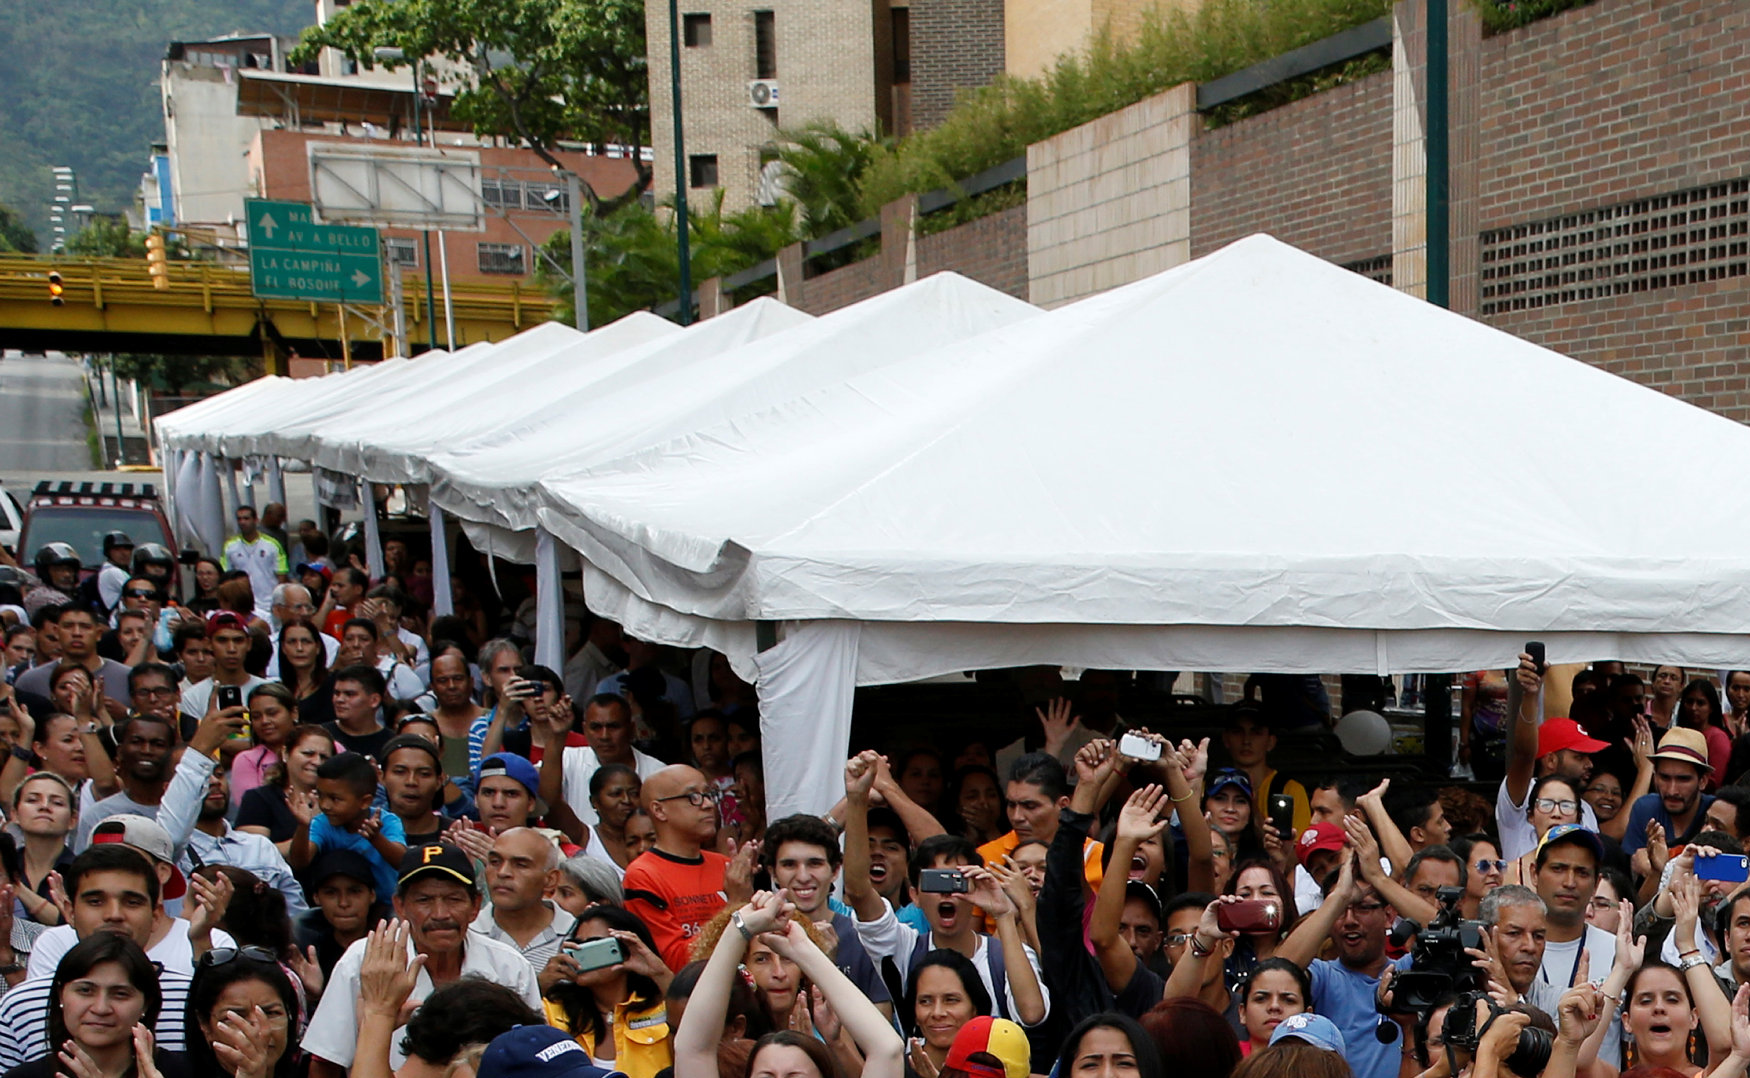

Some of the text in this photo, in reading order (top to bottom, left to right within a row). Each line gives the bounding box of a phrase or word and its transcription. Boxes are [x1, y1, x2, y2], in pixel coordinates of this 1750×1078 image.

[288, 231, 303, 242] AV
[328, 233, 370, 247] BELLO
[261, 257, 342, 273] LA CAMPIÑA
[265, 275, 341, 292] EL BOSQUE
[422, 846, 443, 864] P
